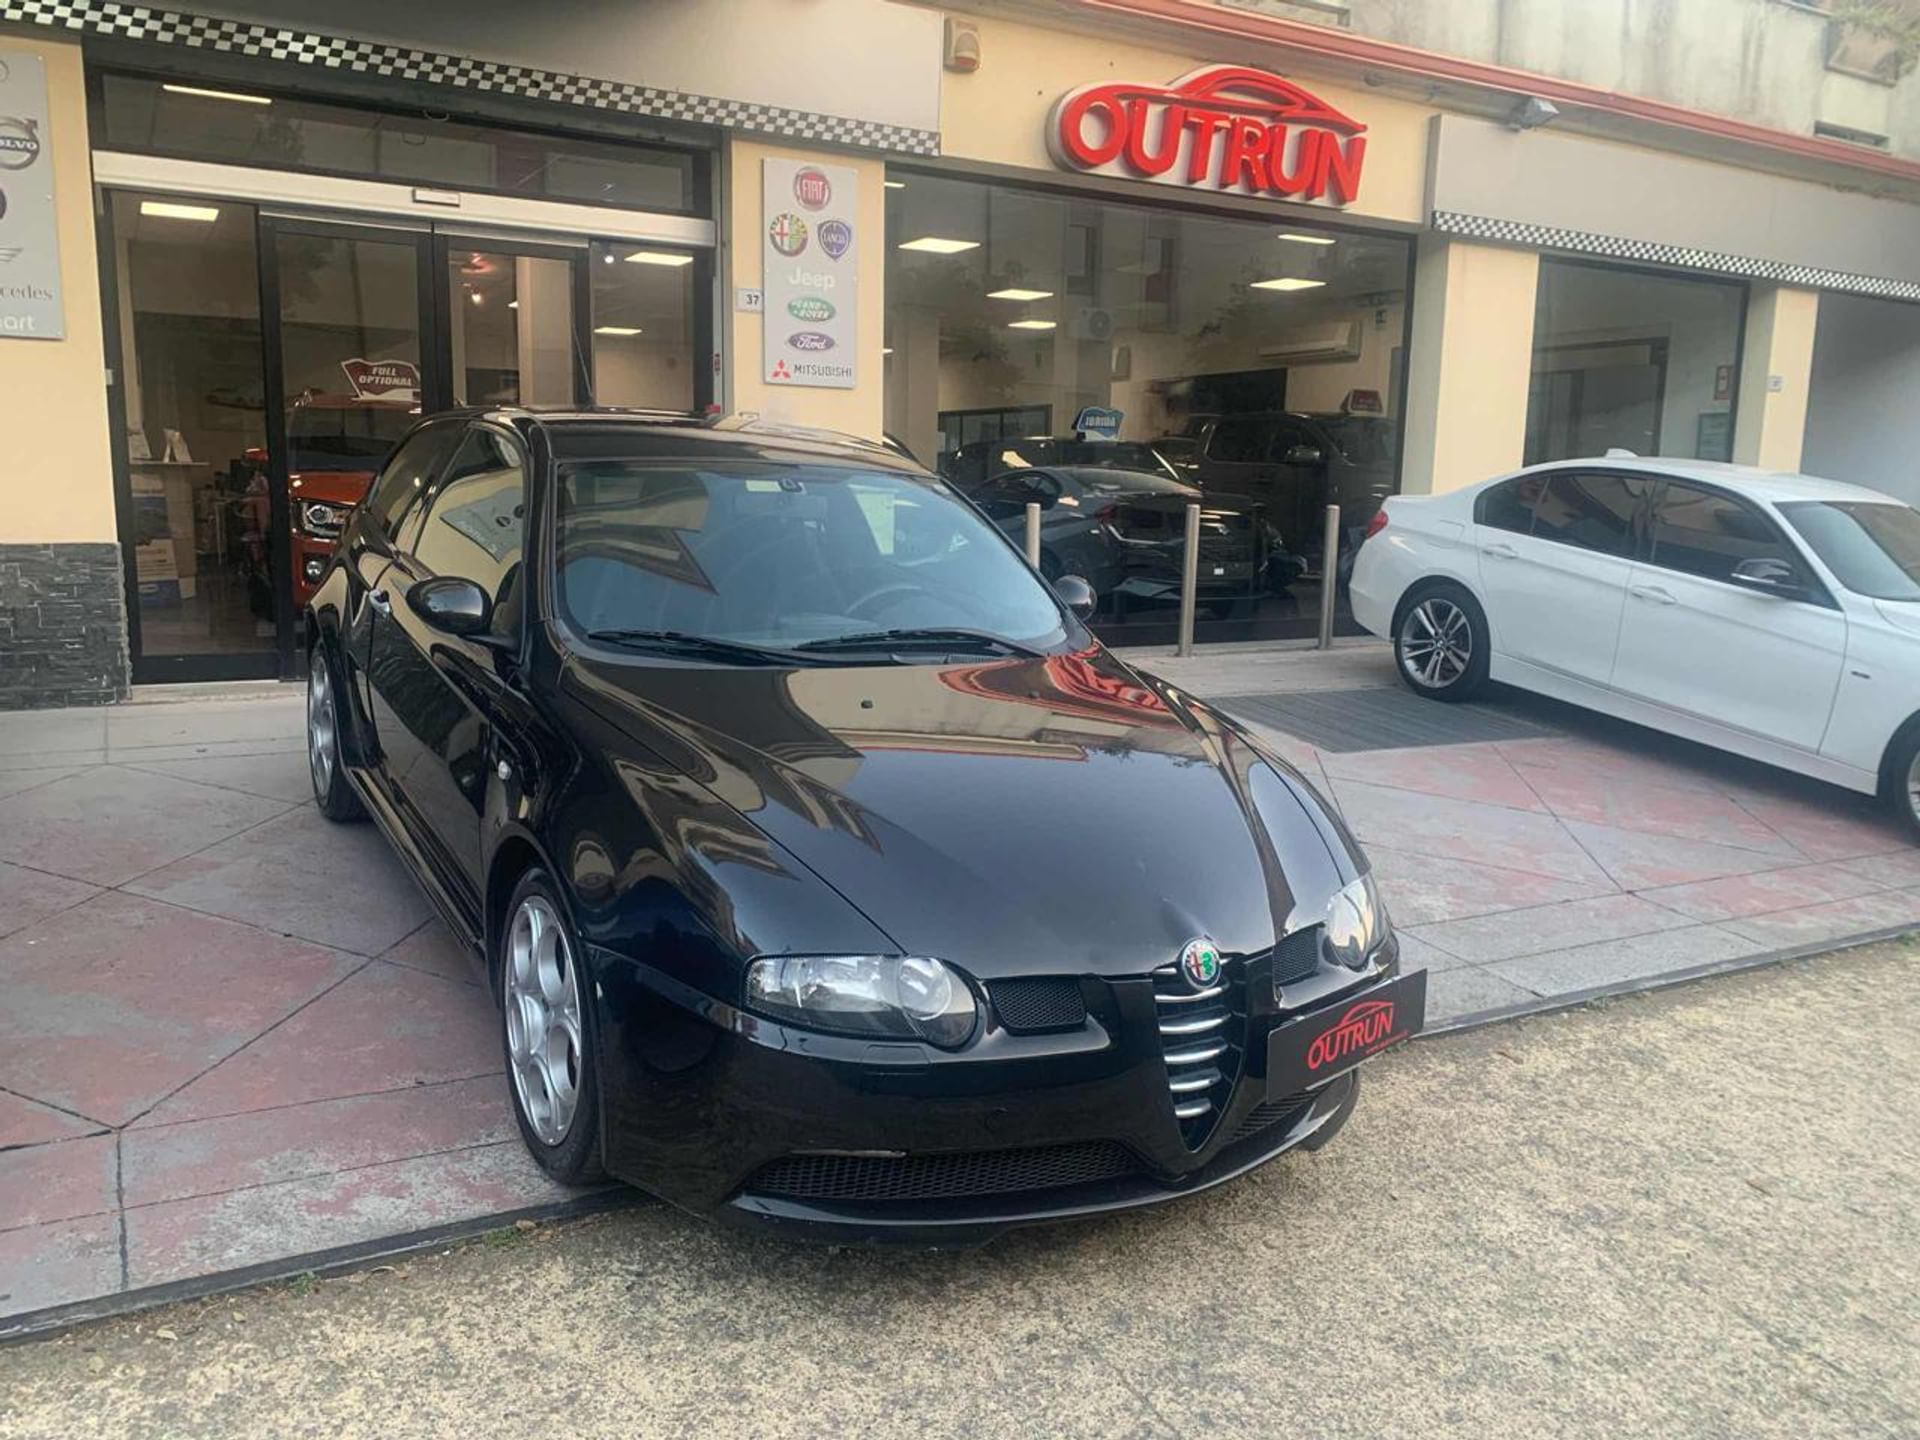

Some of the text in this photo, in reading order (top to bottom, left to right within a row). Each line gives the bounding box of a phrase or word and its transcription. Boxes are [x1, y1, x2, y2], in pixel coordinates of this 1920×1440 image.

[1058, 86, 1367, 203] OUTRUN
[801, 179, 824, 201] FIAT
[788, 267, 835, 291] Jeep
[746, 294, 760, 305] 37
[0, 315, 36, 331] art
[797, 335, 828, 350] Ford
[372, 367, 398, 376] FULL
[794, 363, 852, 378] MITSUBISHI
[359, 375, 412, 386] OPTIONAL
[1307, 1006, 1393, 1070] OUTRUN
